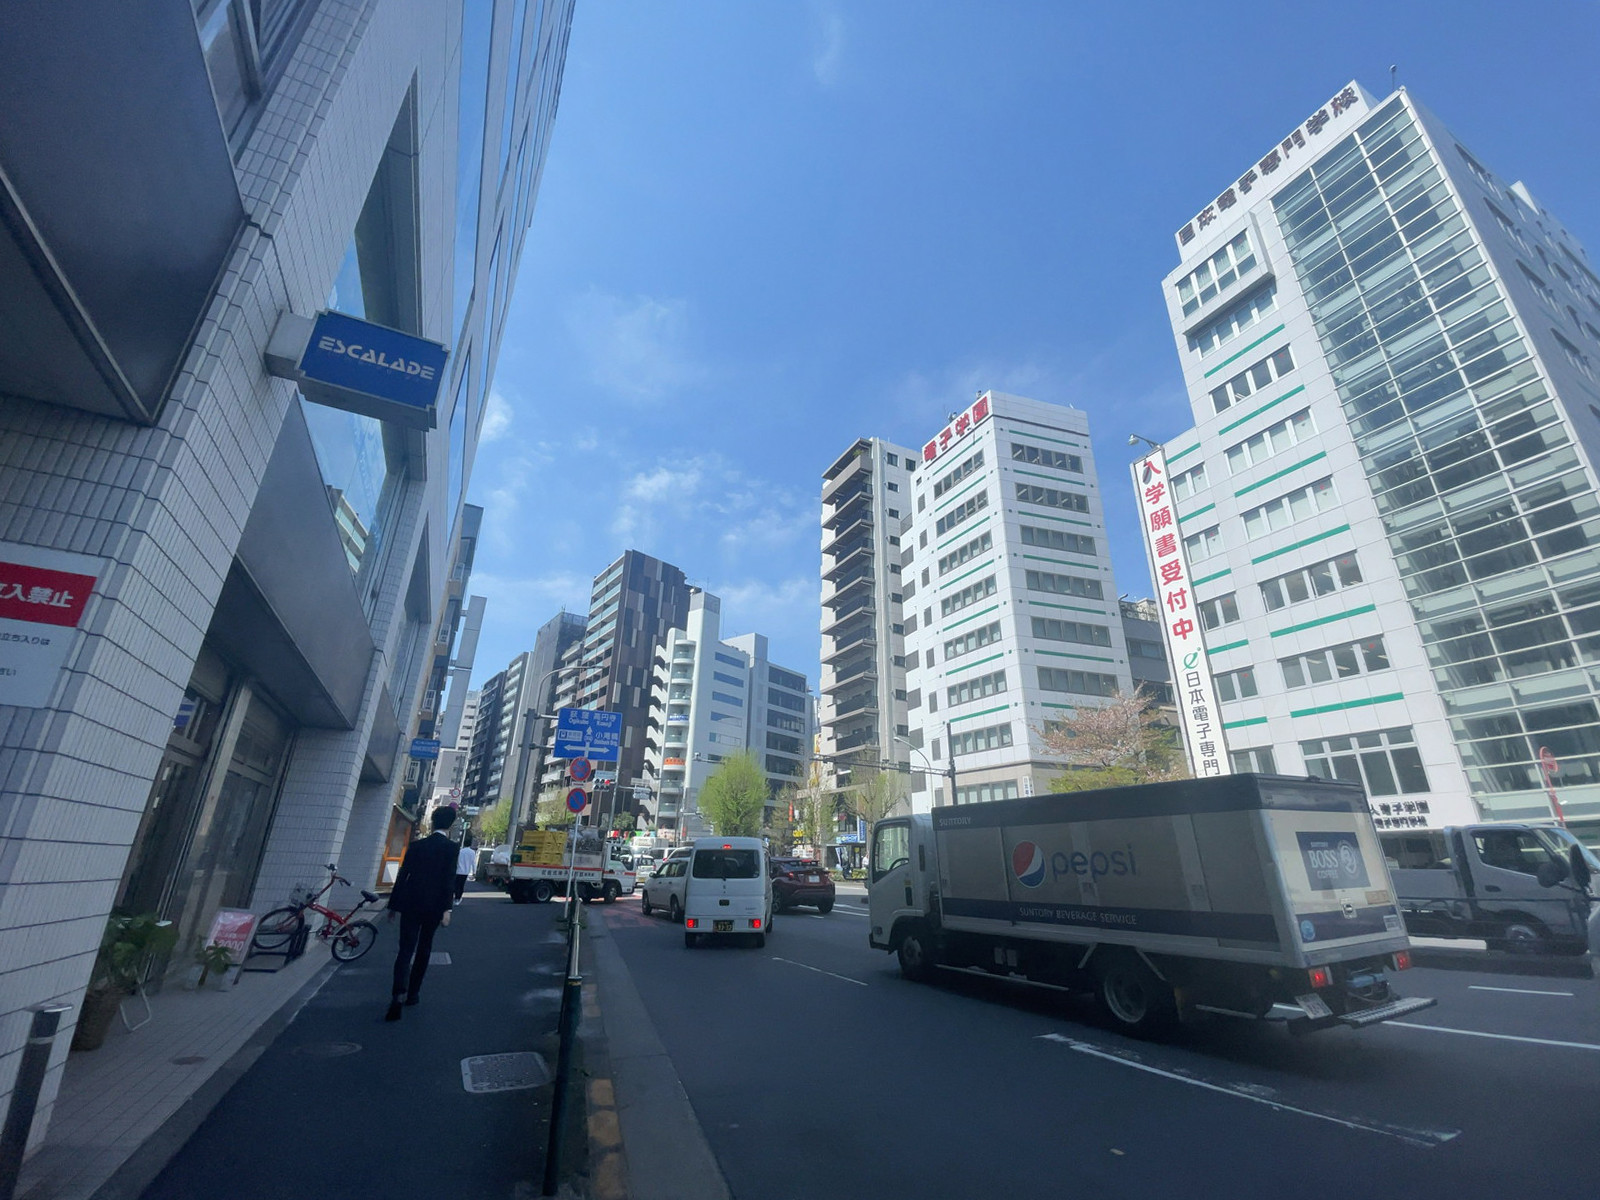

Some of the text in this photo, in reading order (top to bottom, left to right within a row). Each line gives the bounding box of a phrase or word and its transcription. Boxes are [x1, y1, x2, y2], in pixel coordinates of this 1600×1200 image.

[1179, 86, 1358, 246] 日本電子専門学校
[318, 336, 435, 380] ESCALADE
[924, 396, 989, 462] 電子学園
[1143, 460, 1194, 640] 入学願書受付中
[0, 632, 51, 646] 立ち入りは
[1186, 670, 1221, 777] 日本電子専門
[938, 816, 972, 827] SUNTORY
[1051, 843, 1138, 883] pepsi
[1307, 849, 1339, 868] BOSS
[1019, 906, 1138, 925] SUNTORY BEVERAGE SERVICE
